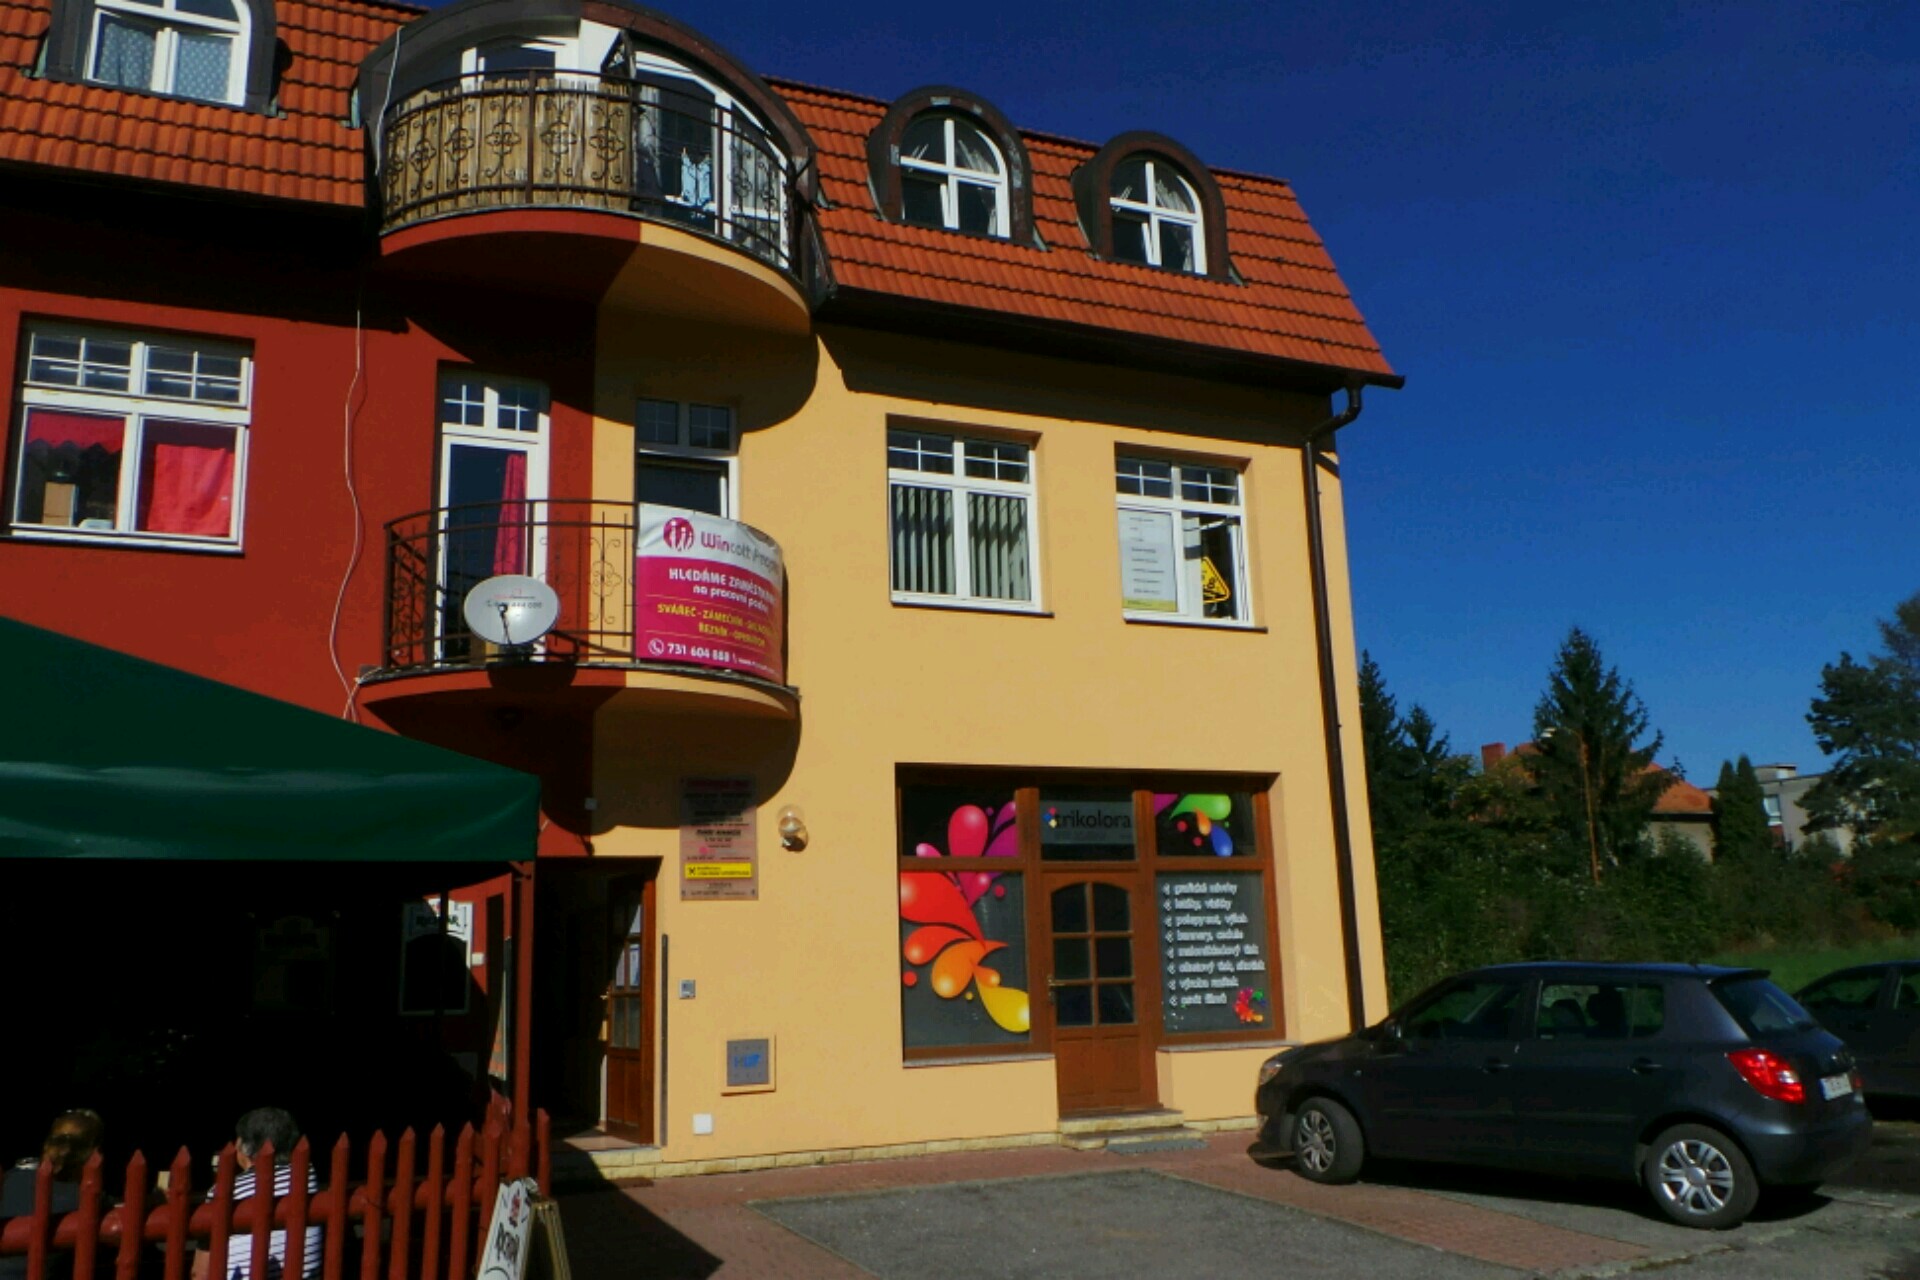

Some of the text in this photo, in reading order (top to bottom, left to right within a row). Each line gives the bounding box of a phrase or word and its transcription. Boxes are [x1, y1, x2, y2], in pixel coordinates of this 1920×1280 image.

[701, 531, 750, 559] Wincott
[669, 567, 726, 585] HLEDÁME
[693, 585, 707, 596] na
[711, 586, 747, 604] pracovní
[667, 642, 686, 655] 731
[691, 646, 710, 658] 604
[1055, 809, 1131, 828] trikolora
